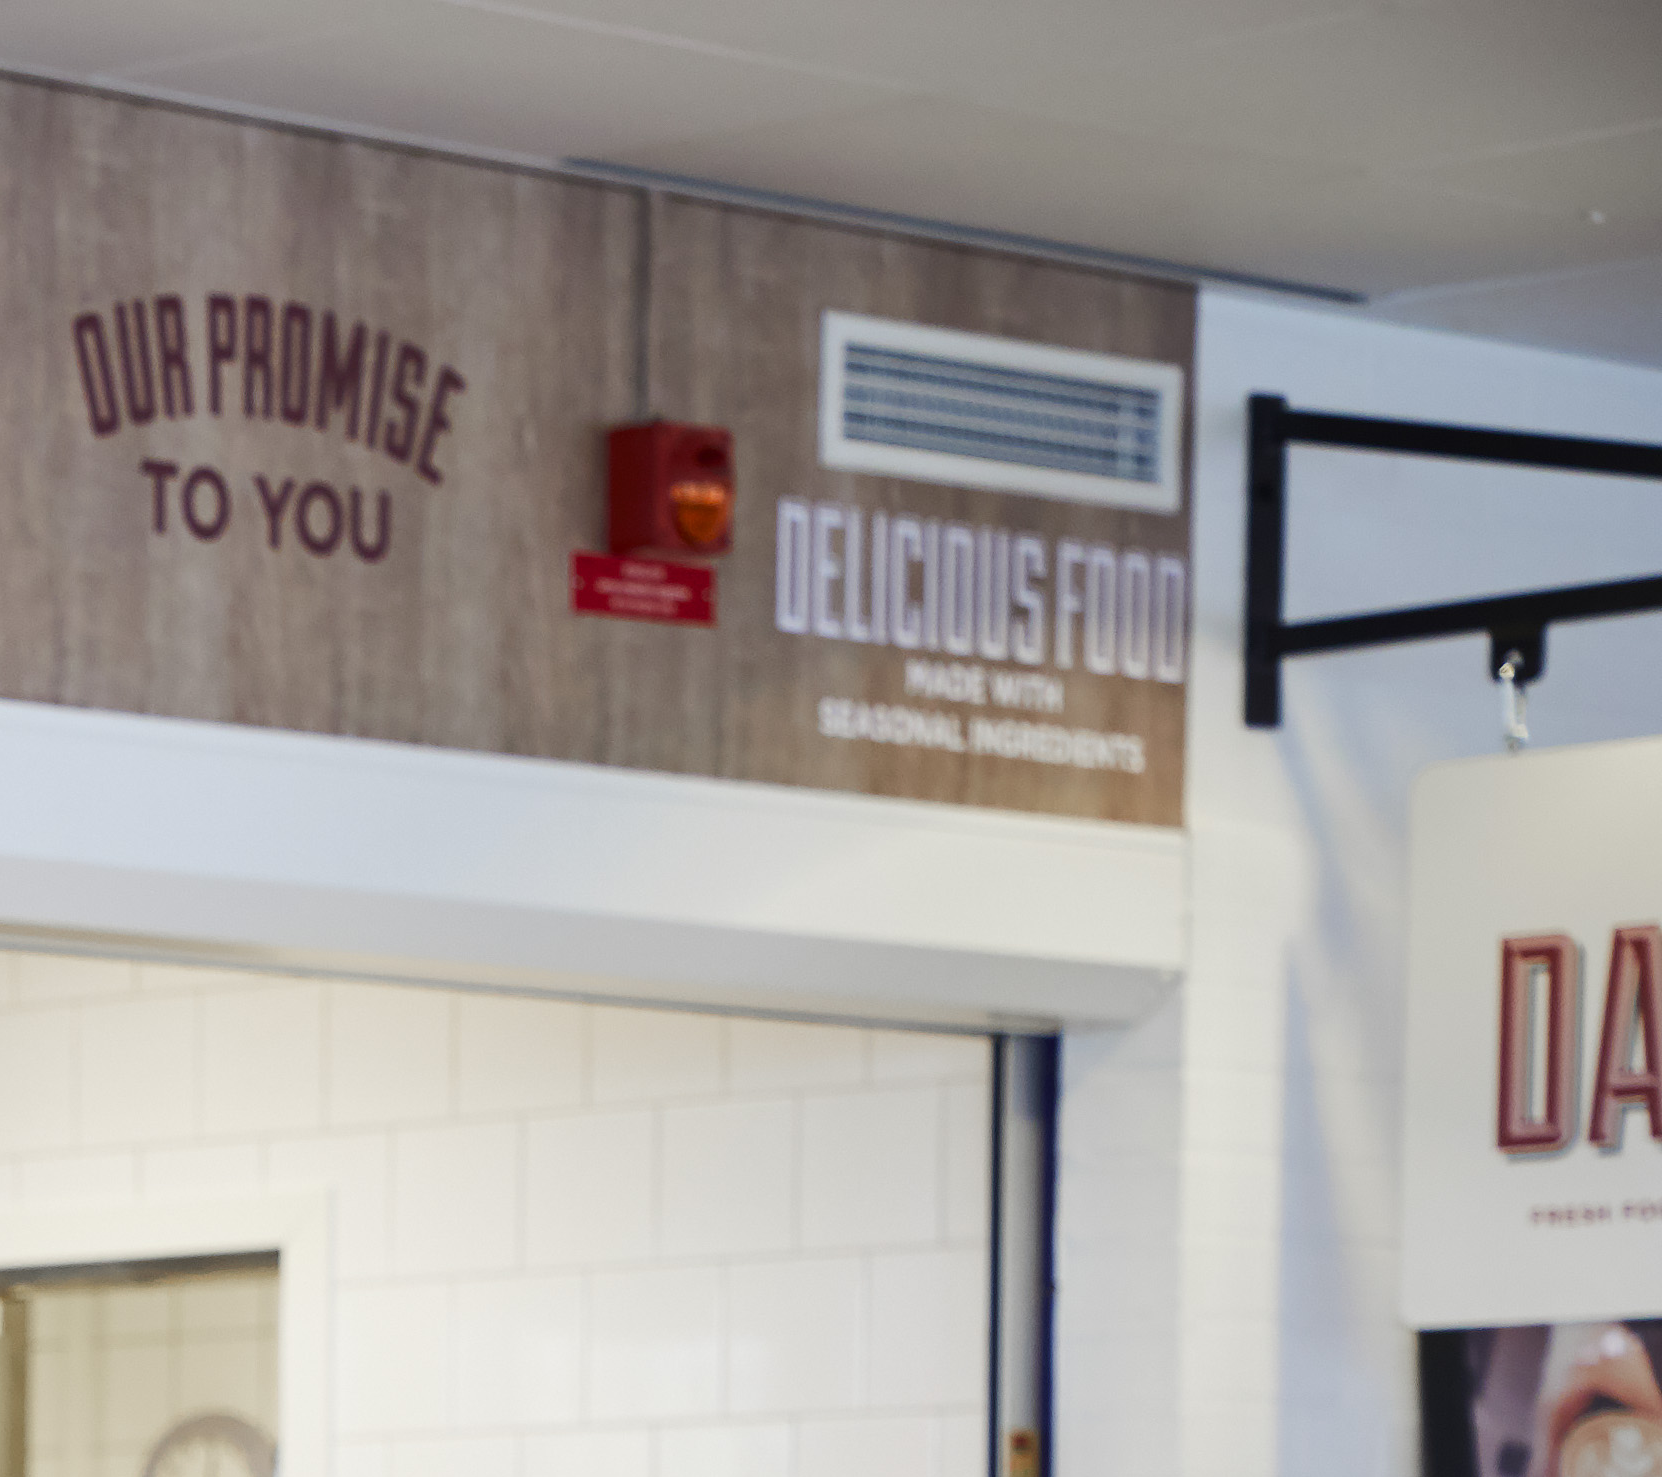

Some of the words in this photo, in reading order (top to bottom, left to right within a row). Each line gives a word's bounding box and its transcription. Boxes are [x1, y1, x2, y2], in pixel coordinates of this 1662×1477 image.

[72, 293, 194, 438] OUR
[207, 291, 465, 487] PROMISE
[141, 457, 231, 543] TO
[254, 472, 392, 563] YOU
[776, 497, 1046, 667] DELICIOUS
[1054, 535, 1185, 683] FOOD
[818, 698, 966, 752] SEASONAL
[970, 715, 1146, 774] INGREDIENTS
[905, 658, 989, 708] MADE
[991, 667, 1064, 714] WITH
